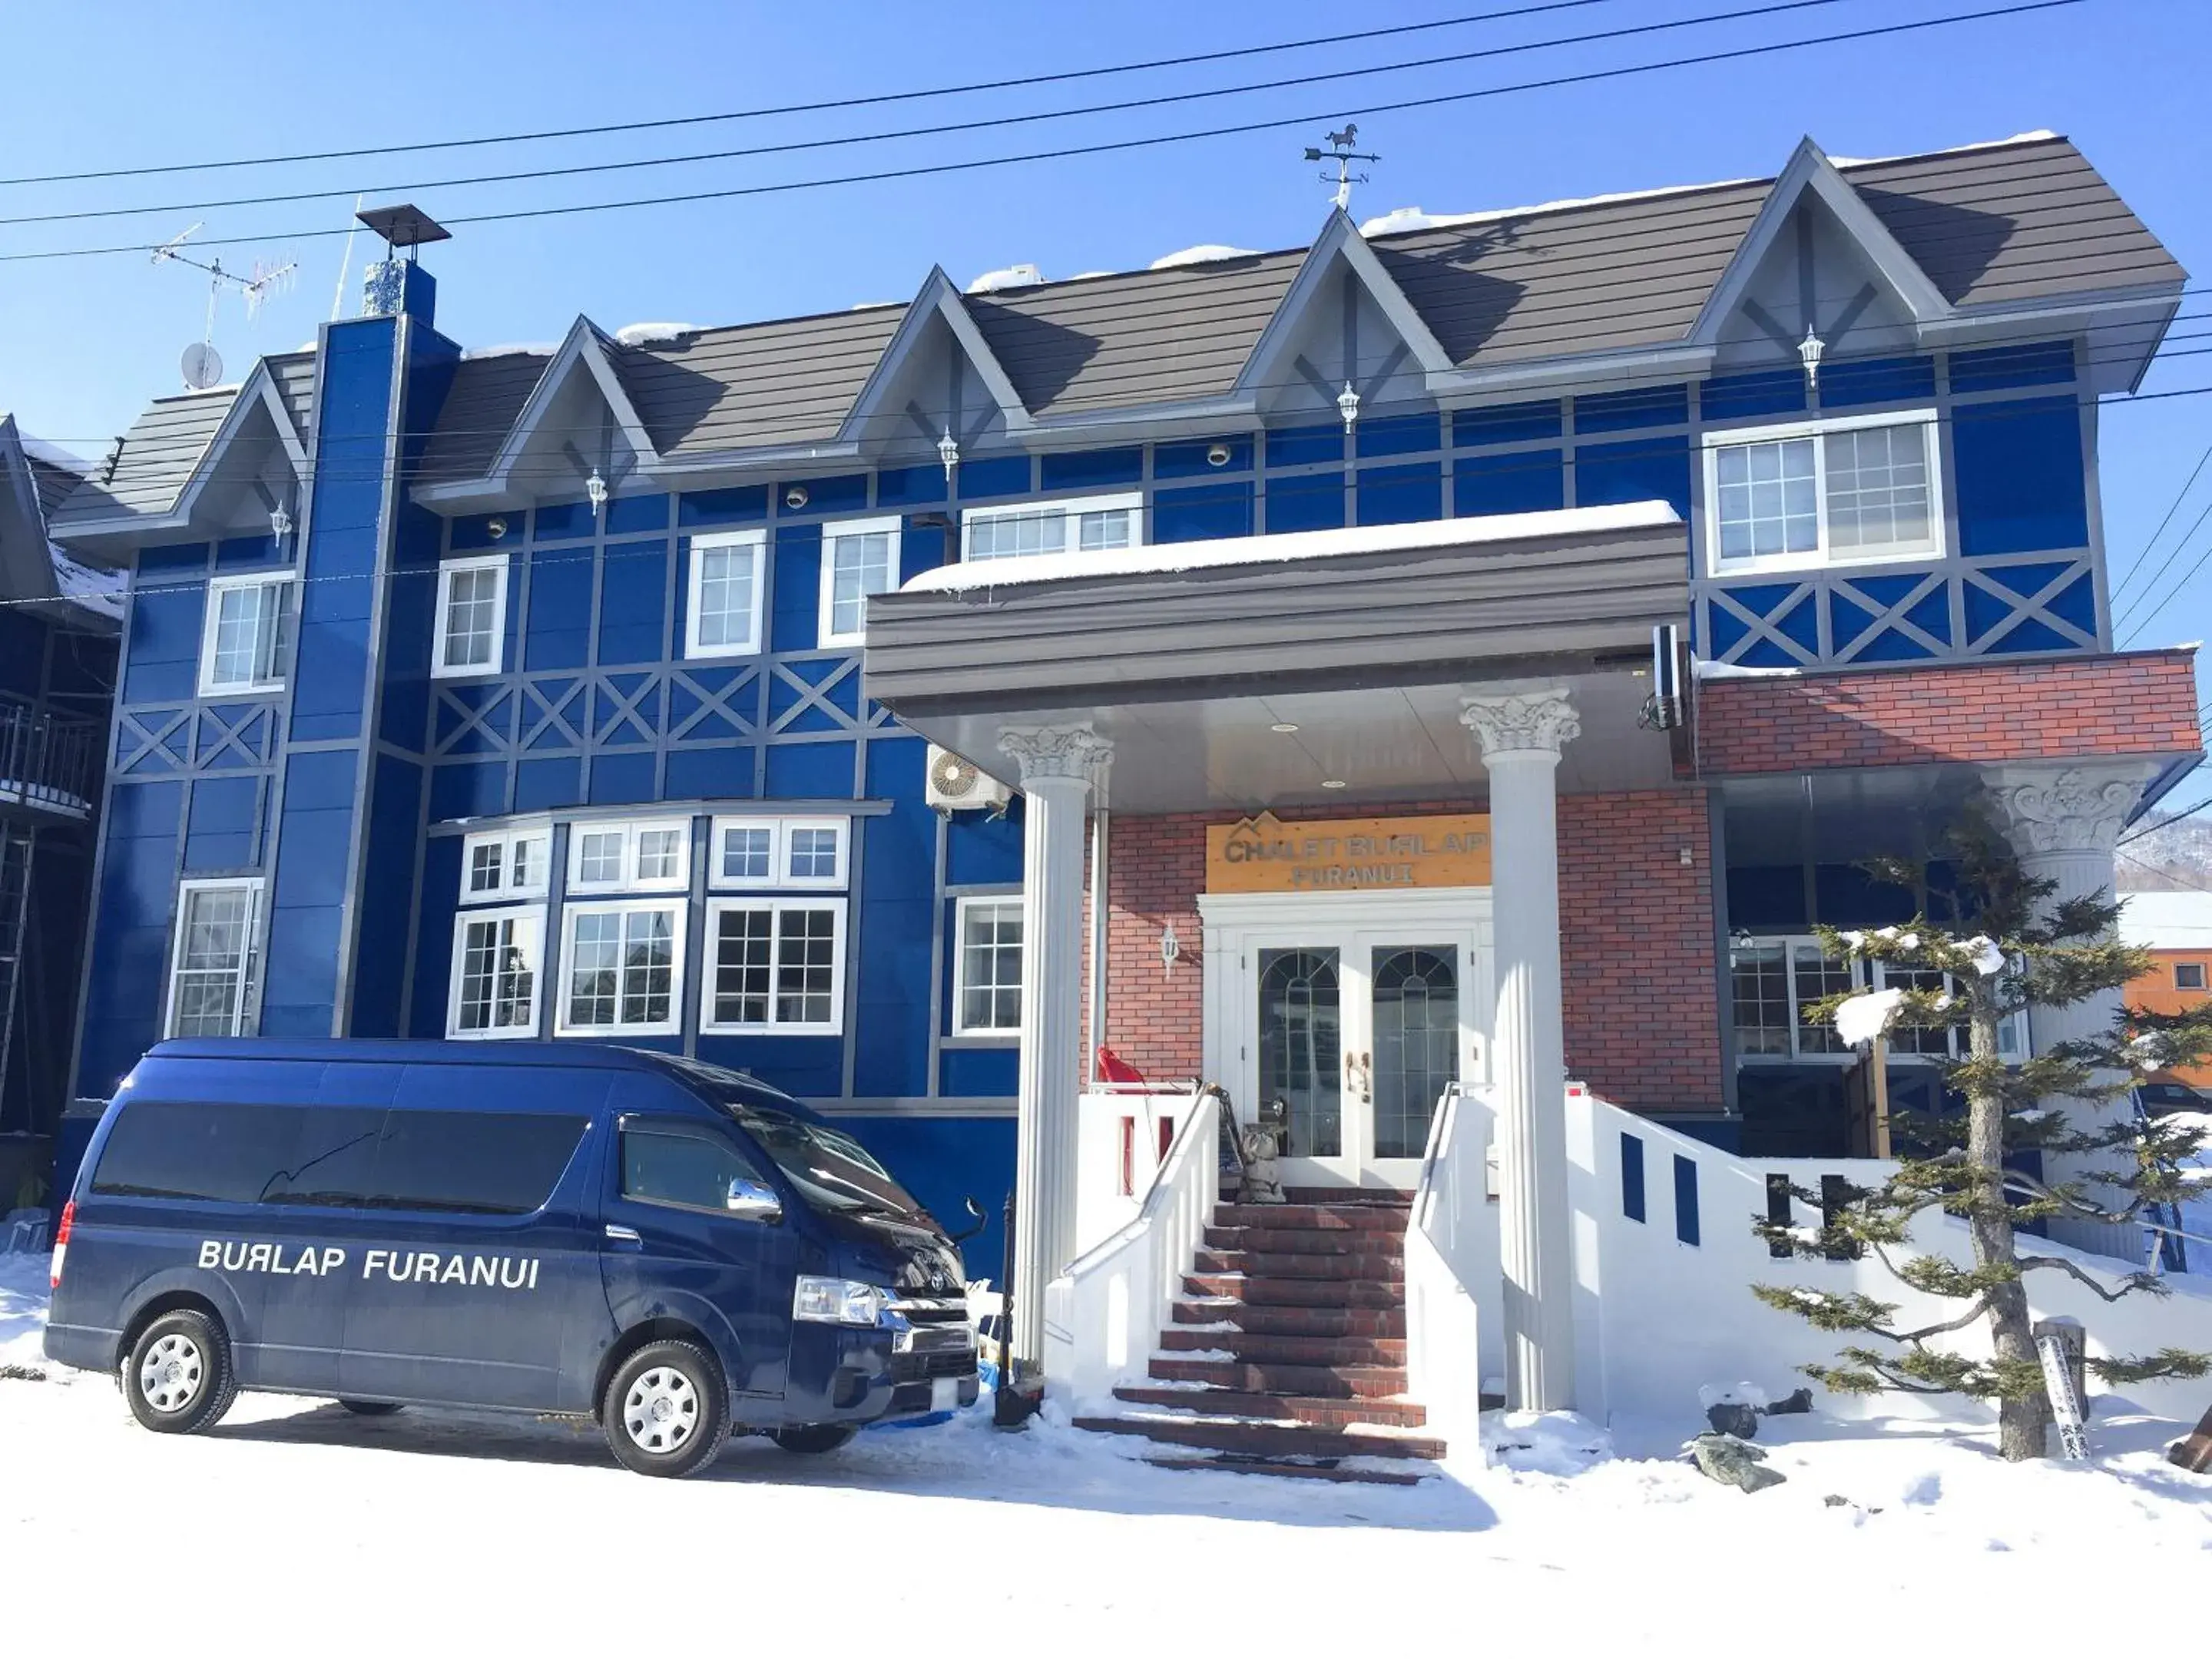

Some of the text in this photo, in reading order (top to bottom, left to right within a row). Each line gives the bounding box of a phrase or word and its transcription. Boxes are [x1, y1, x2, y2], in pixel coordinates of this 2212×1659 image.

[1224, 836, 1337, 863] CHALET
[1292, 862, 1416, 887] FURANUI
[363, 1250, 540, 1289] FURANUI
